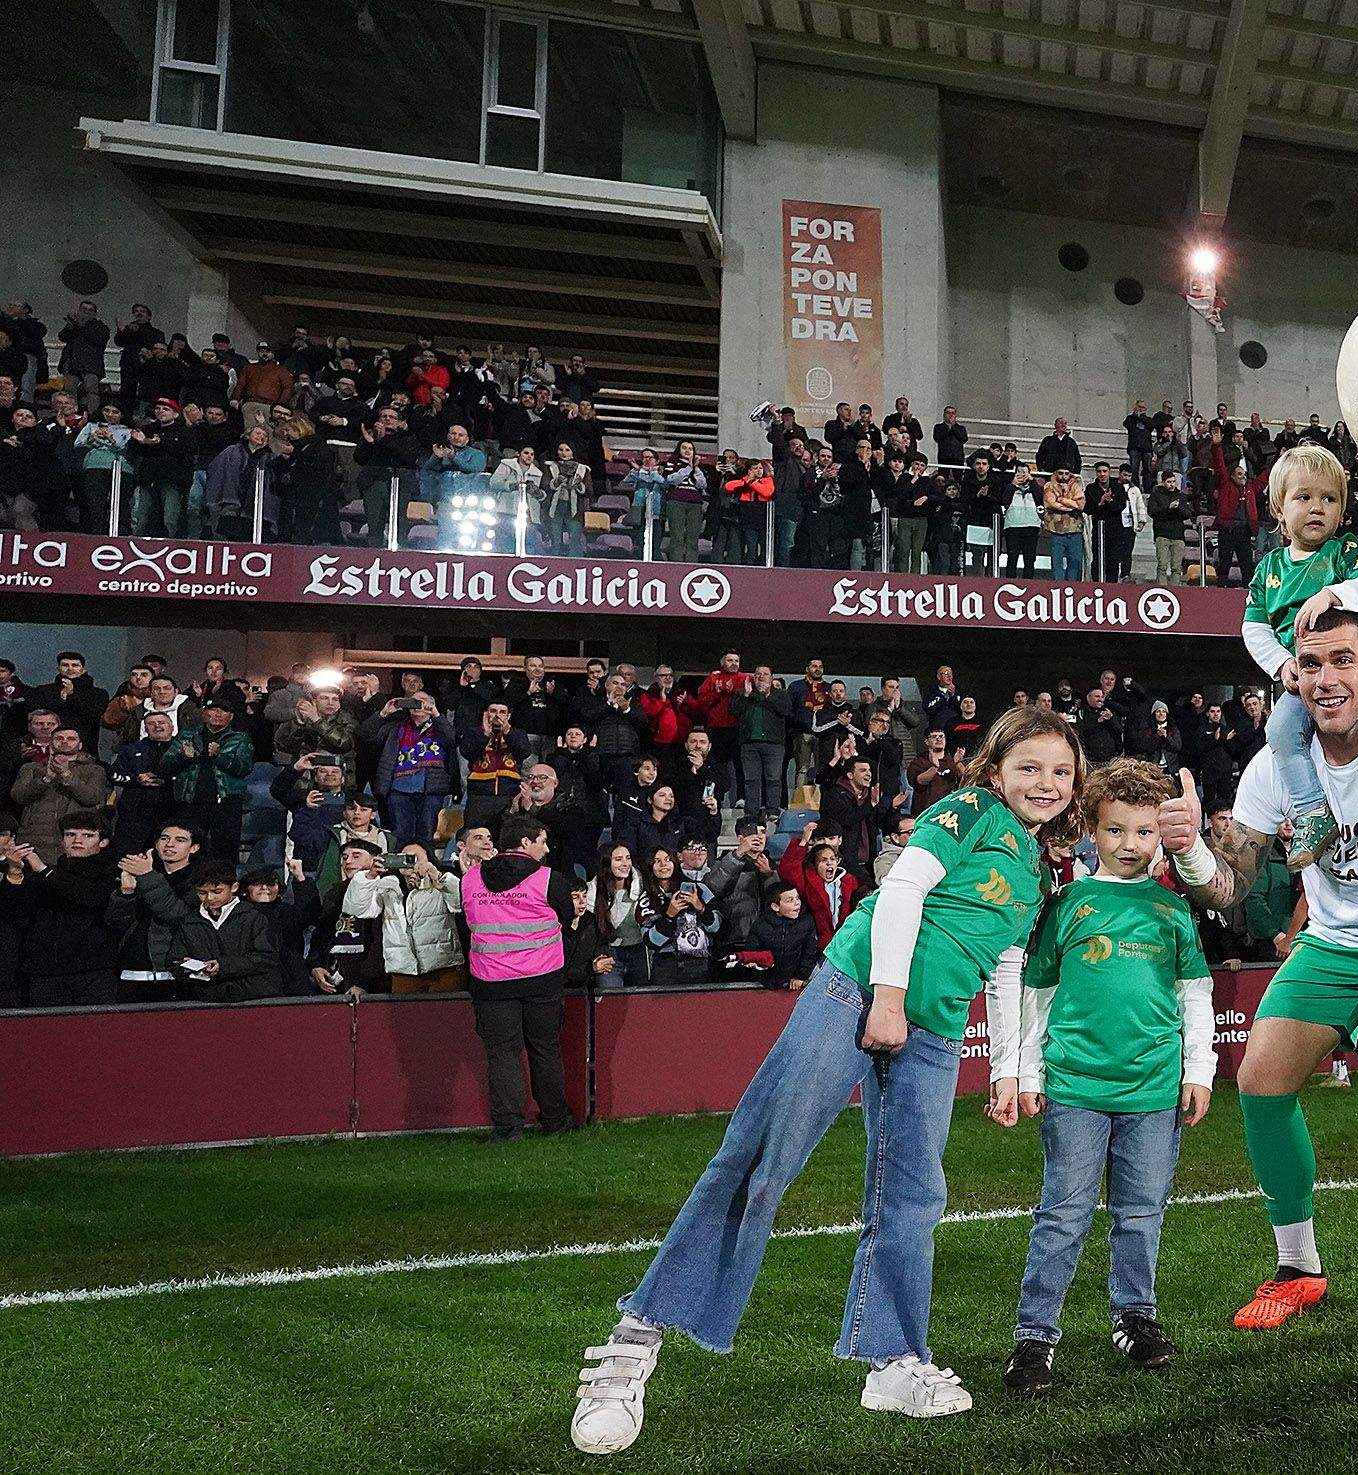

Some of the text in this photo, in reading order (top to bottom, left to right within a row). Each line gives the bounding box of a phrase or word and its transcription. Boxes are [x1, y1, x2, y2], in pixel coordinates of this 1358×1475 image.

[790, 216, 854, 242] FOR
[791, 242, 834, 265] ZA
[791, 267, 858, 293] PON
[791, 292, 873, 319] TEVE
[791, 317, 859, 343] DRA
[91, 541, 272, 582] exalta
[99, 579, 258, 597] centro deportivo
[302, 553, 670, 608] Estrella Galicia
[828, 577, 1130, 626] Estrella Galicia
[1215, 1009, 1246, 1025] ello
